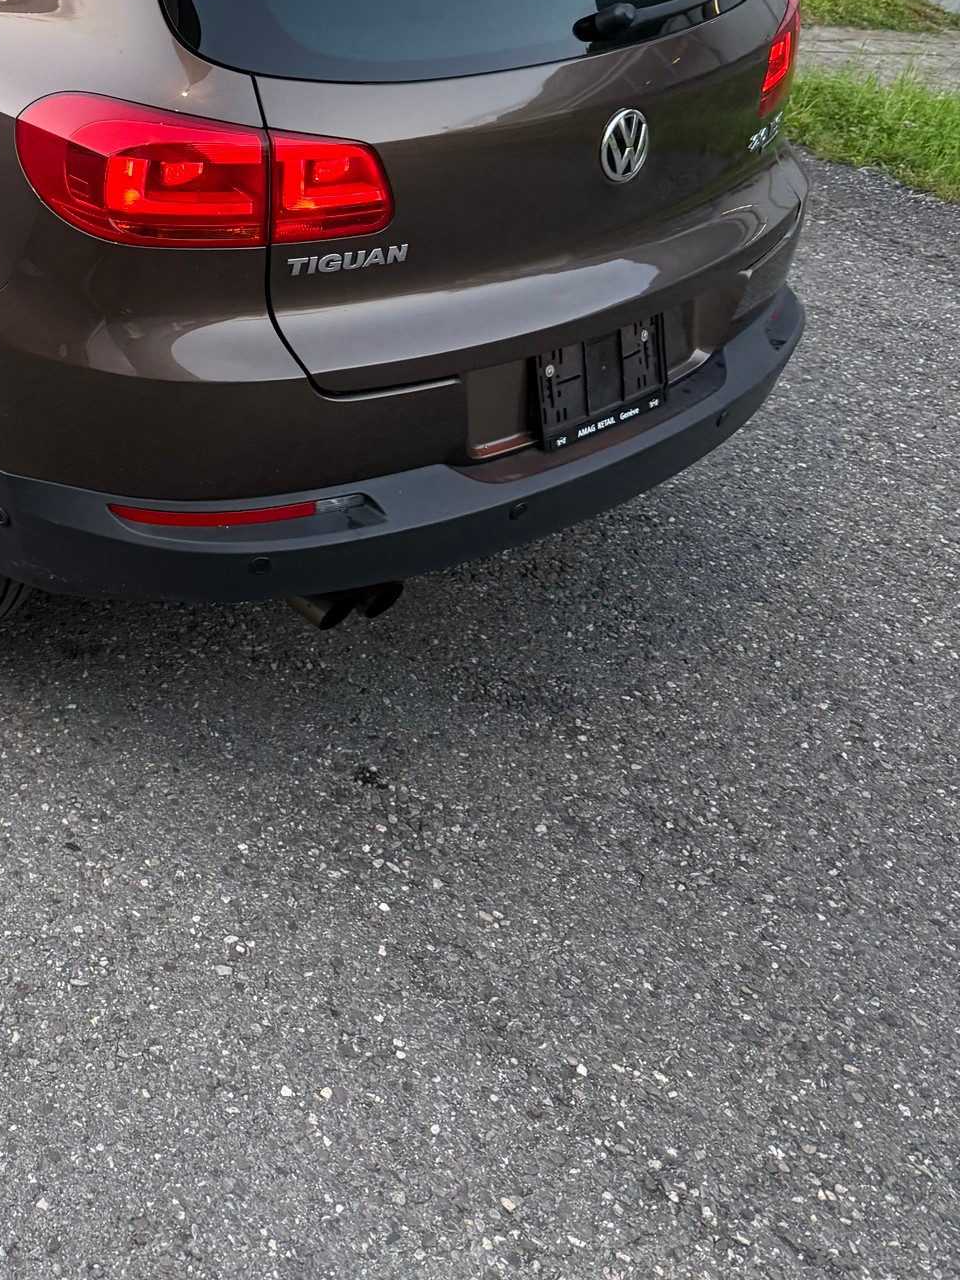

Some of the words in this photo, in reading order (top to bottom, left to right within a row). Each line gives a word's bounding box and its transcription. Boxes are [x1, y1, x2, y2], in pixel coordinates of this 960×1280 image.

[287, 243, 408, 276] TIGUAN
[577, 424, 596, 438] AMAG
[597, 416, 616, 430] RETAIL
